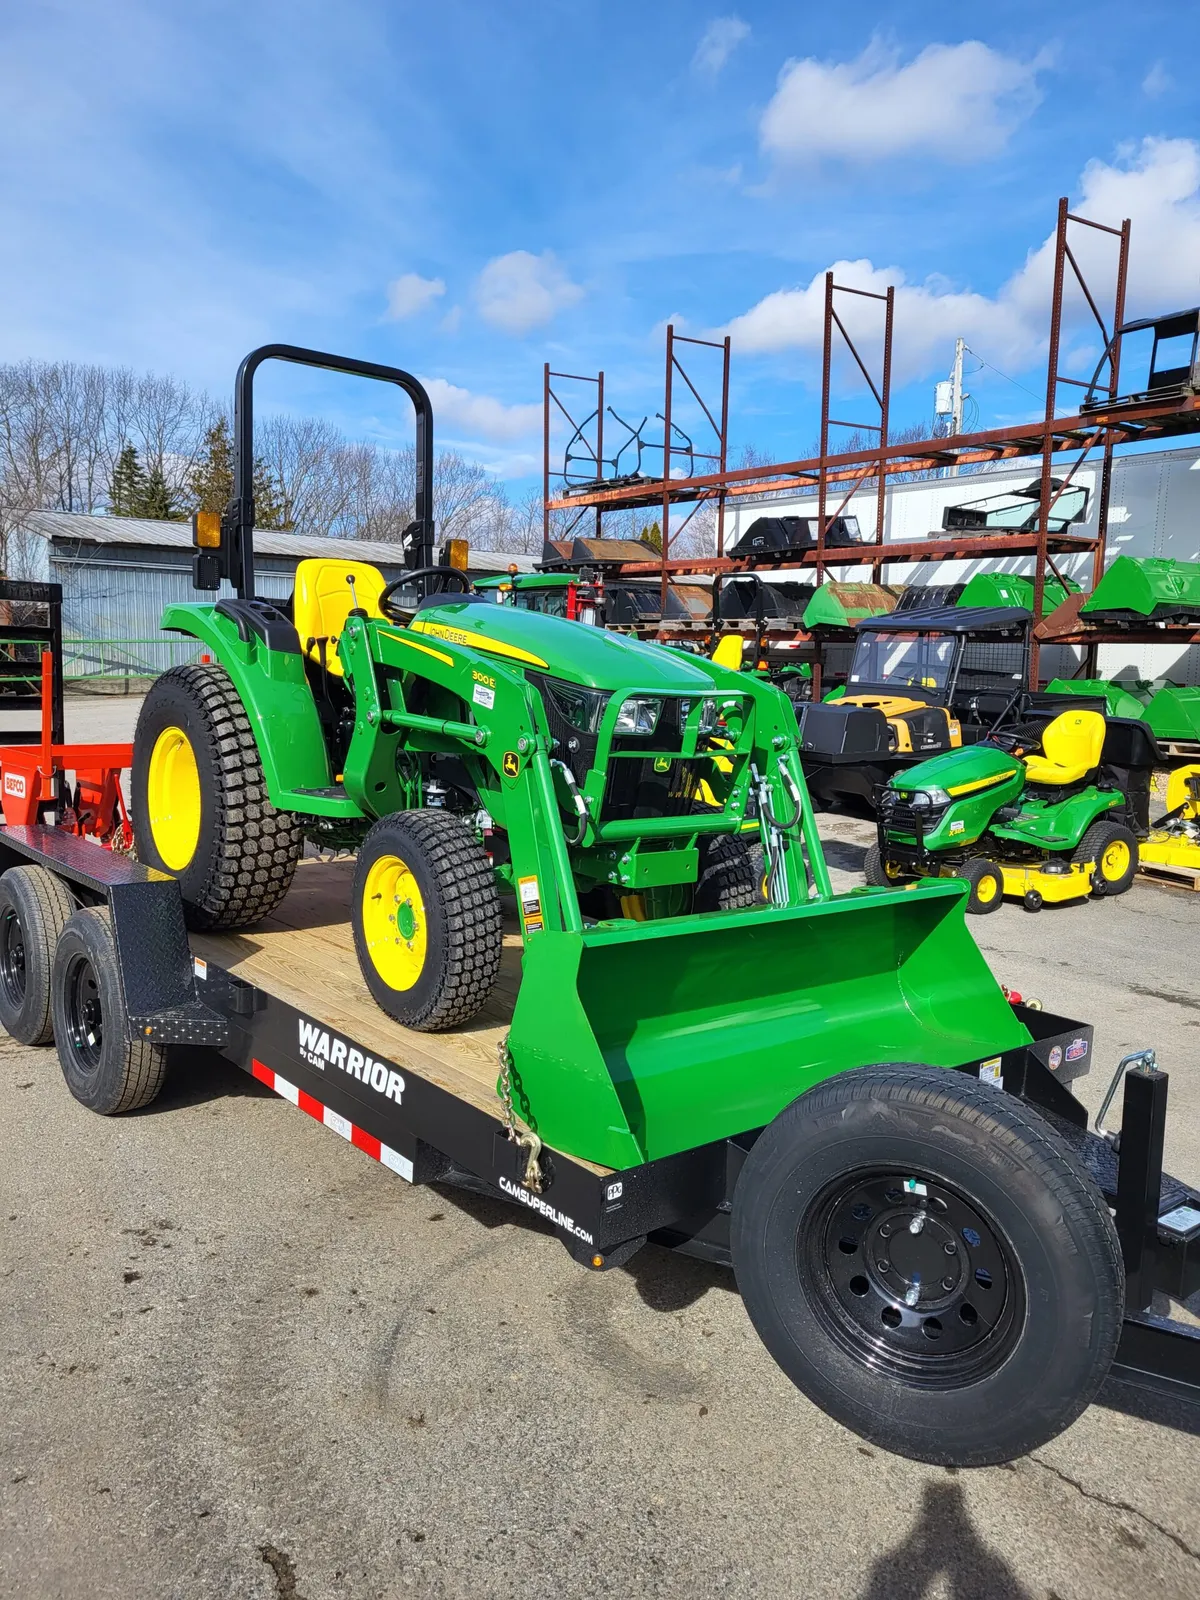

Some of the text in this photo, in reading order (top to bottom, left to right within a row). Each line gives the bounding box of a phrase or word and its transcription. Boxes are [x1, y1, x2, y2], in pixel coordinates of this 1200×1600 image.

[430, 626, 468, 644] JOHN DEERE
[6, 777, 24, 793] BEFCO
[298, 1018, 405, 1106] WARRIOR
[299, 1046, 325, 1071] By CAM
[608, 1184, 622, 1198] PPG
[499, 1176, 594, 1245] CAMSUPERLINE.COM
